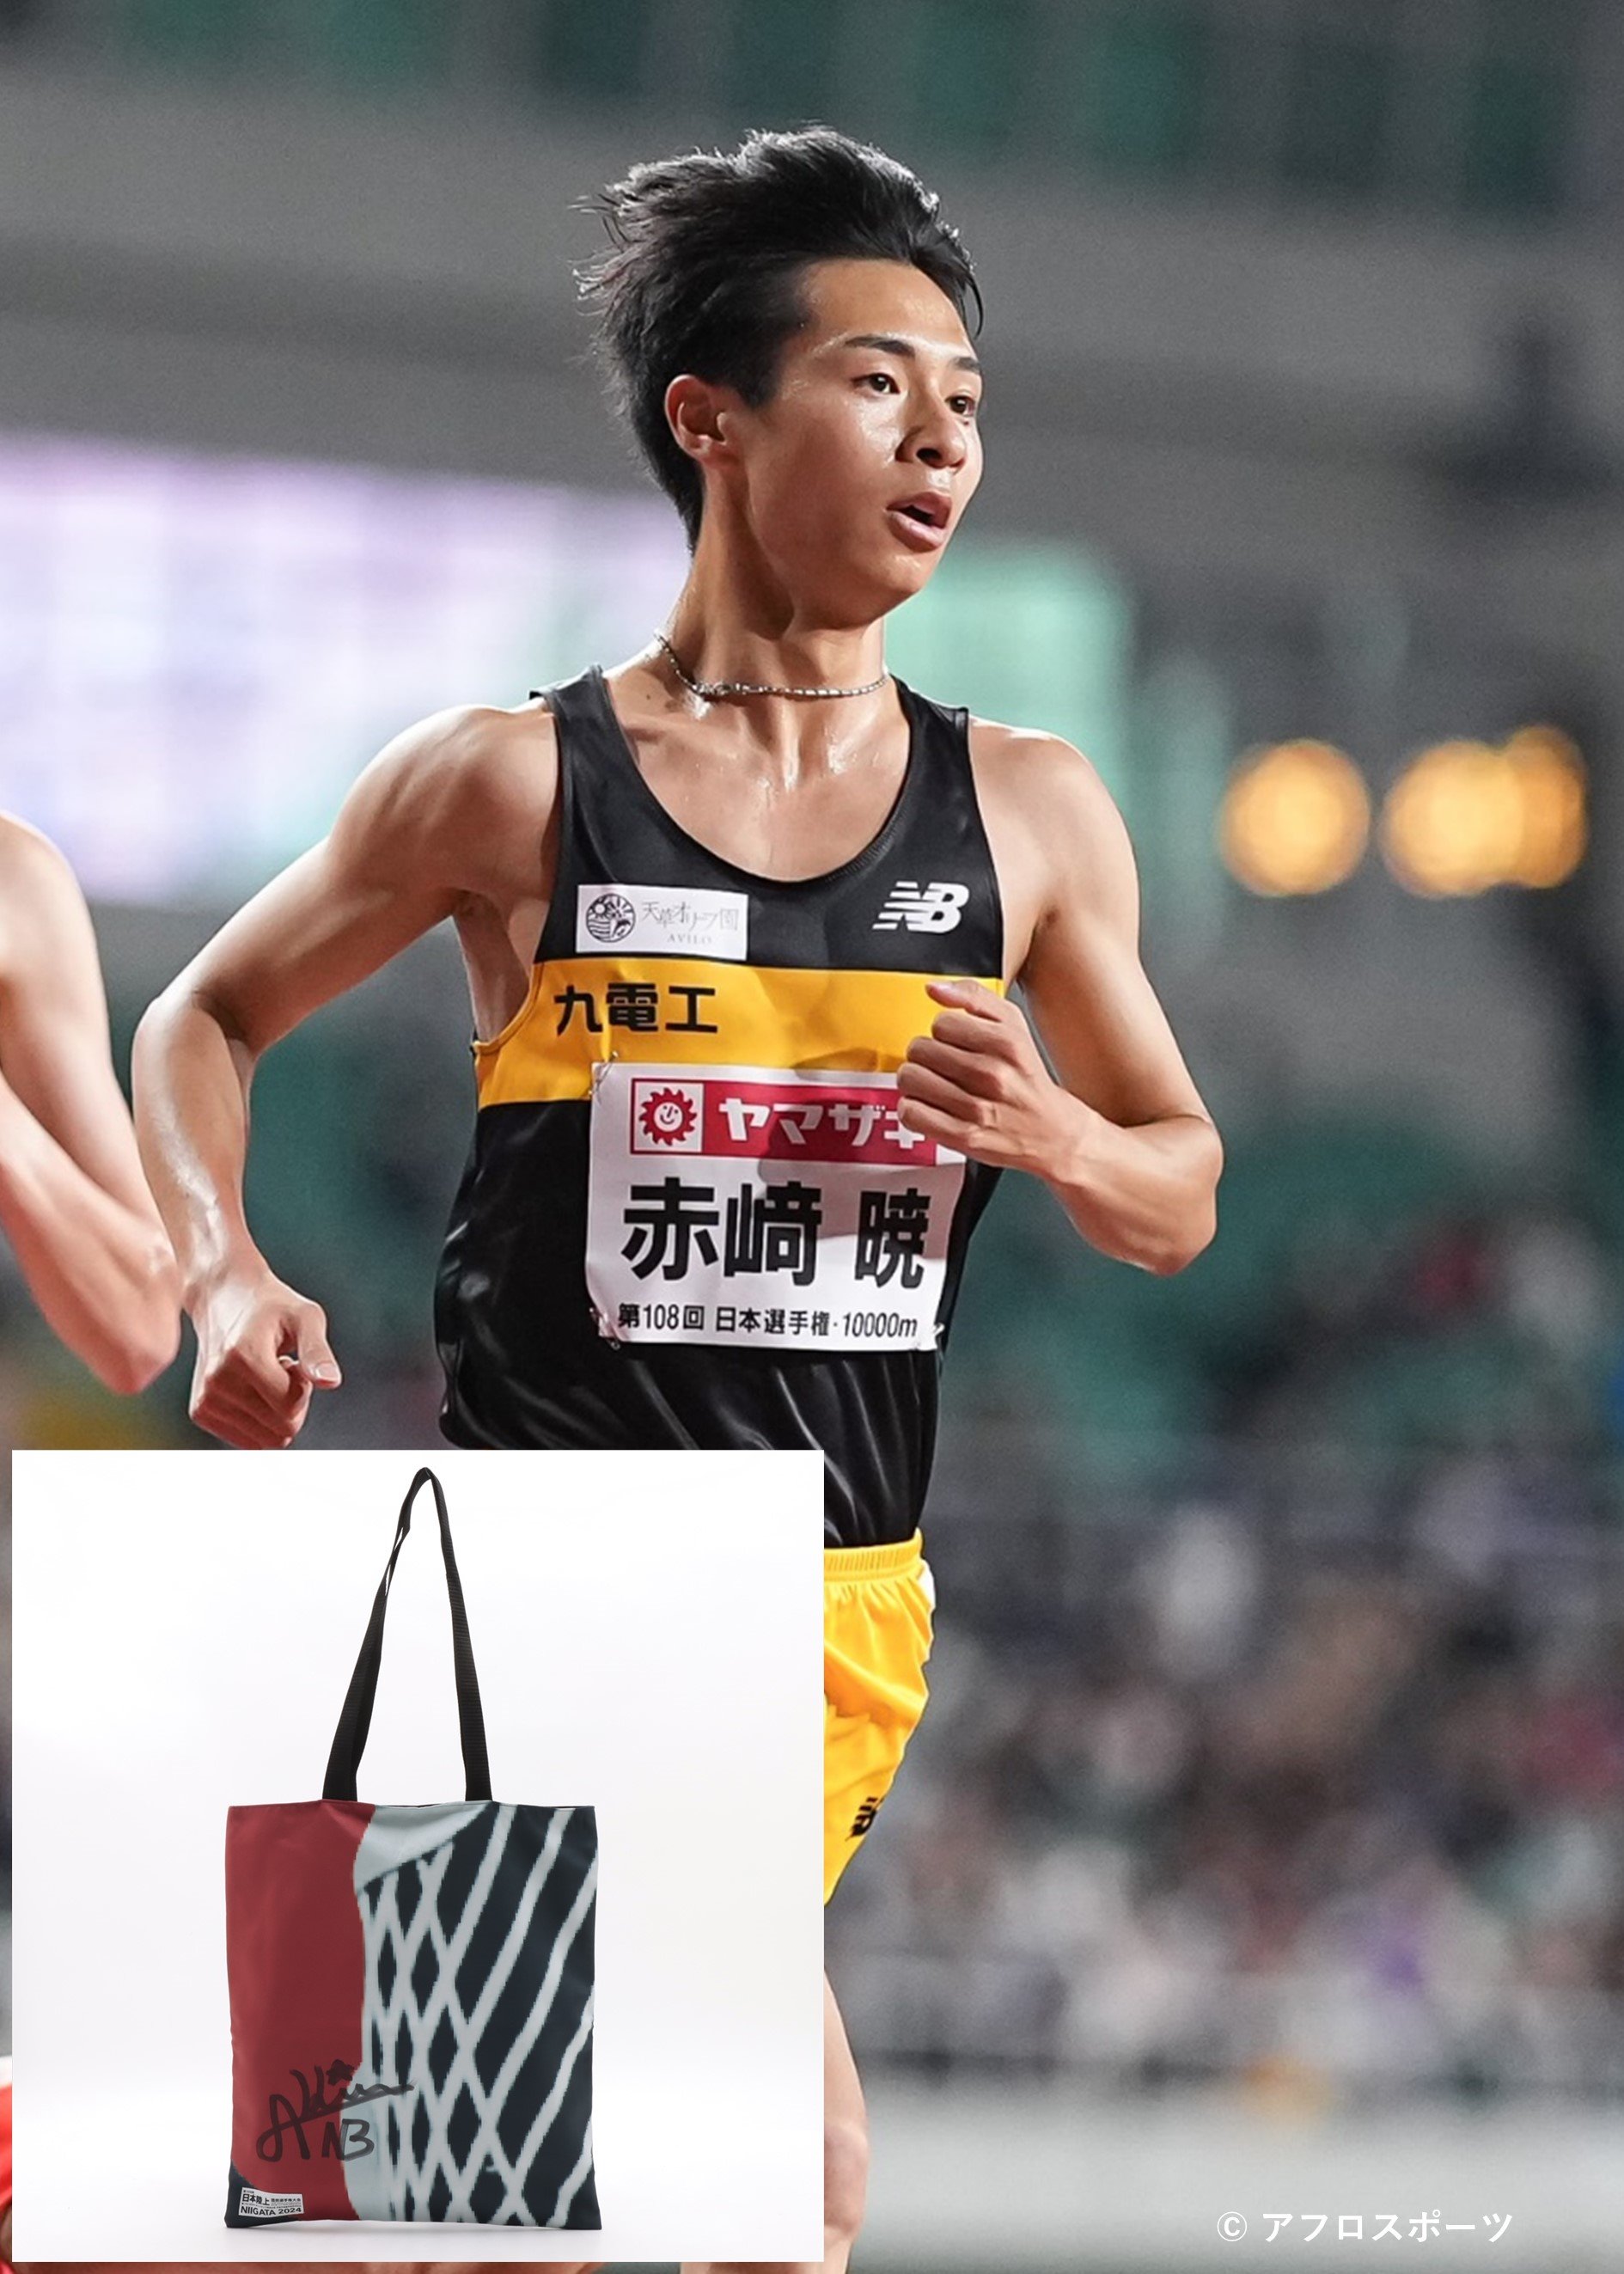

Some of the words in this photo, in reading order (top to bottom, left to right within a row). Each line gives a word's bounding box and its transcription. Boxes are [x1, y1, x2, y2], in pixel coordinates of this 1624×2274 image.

[553, 981, 718, 1034] 九電工
[718, 1097, 925, 1149] ヤマザキ
[854, 1188, 931, 1289] 暁
[618, 1303, 705, 1330] 第108回
[241, 2206, 276, 2216] NIIGATA
